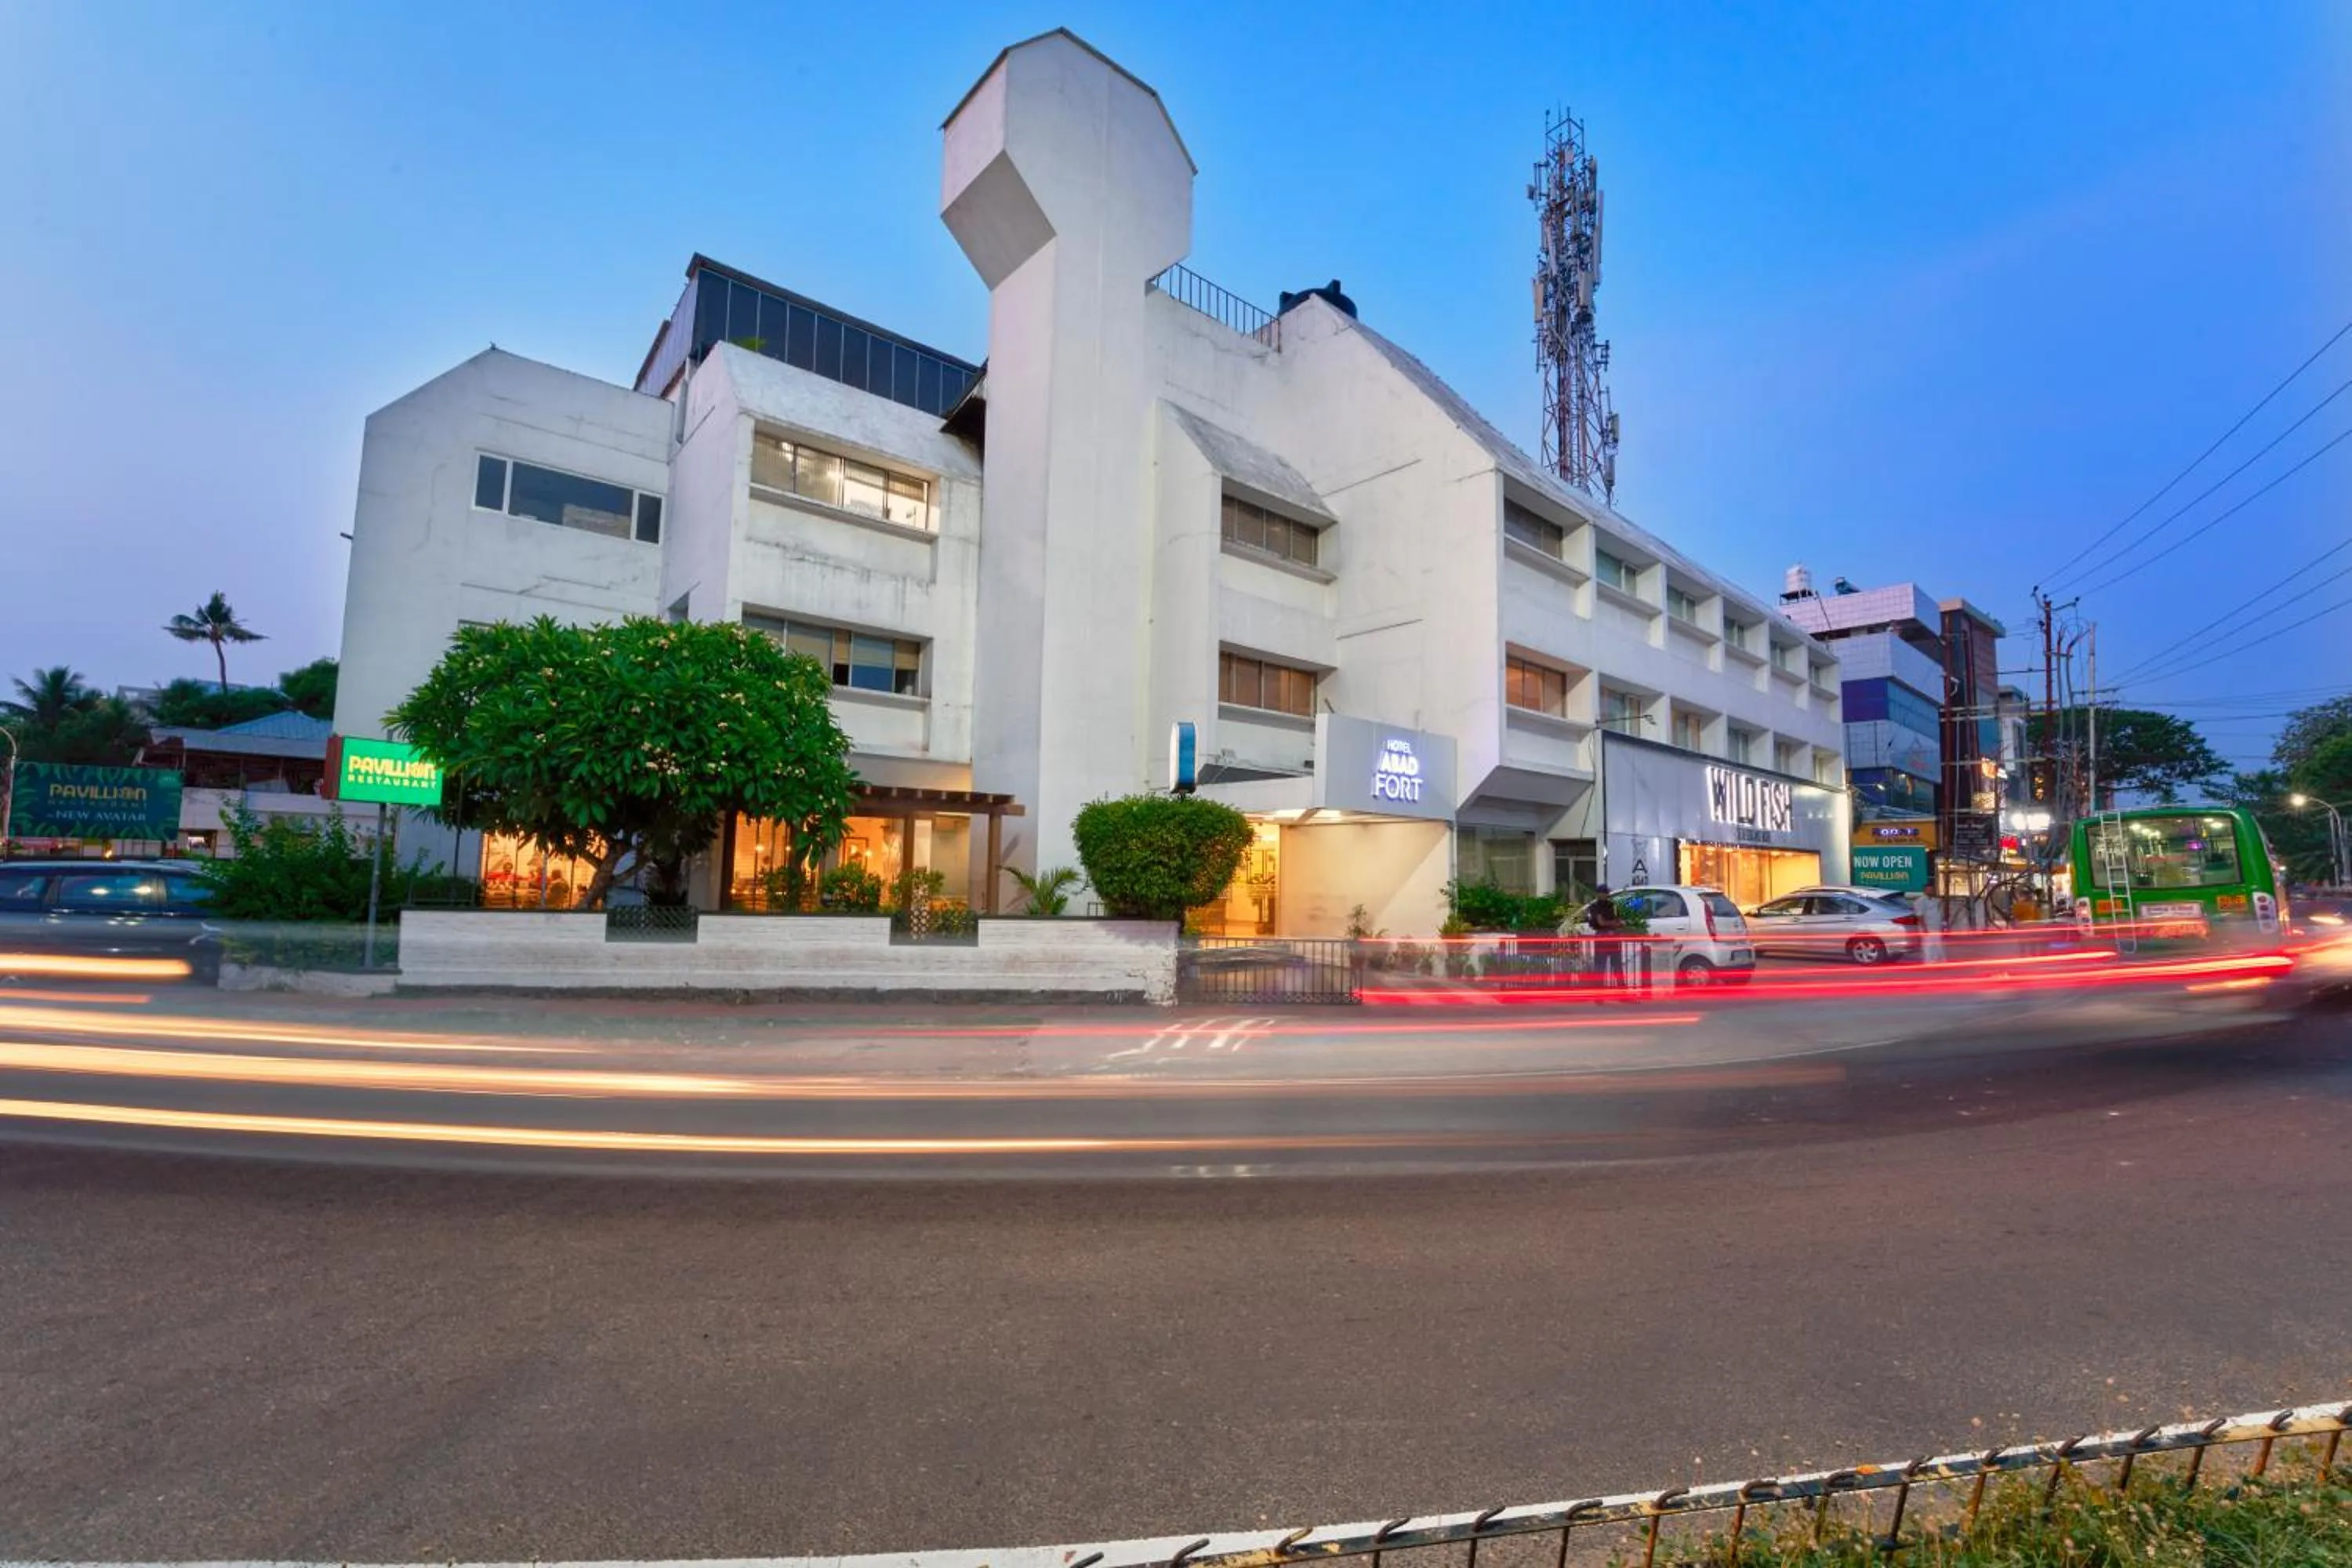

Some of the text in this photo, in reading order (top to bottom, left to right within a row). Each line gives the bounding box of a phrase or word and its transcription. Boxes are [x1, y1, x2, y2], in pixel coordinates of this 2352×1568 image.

[348, 755, 436, 779] PAVILLION
[347, 773, 437, 789] RESTAURANT
[1374, 773, 1425, 800] FORT
[49, 783, 147, 800] PAVILLION
[1706, 765, 1793, 833] WILD FISH
[55, 809, 90, 819] NEW
[94, 810, 147, 822] AVATAR
[1853, 855, 1913, 869] NOW OPEN
